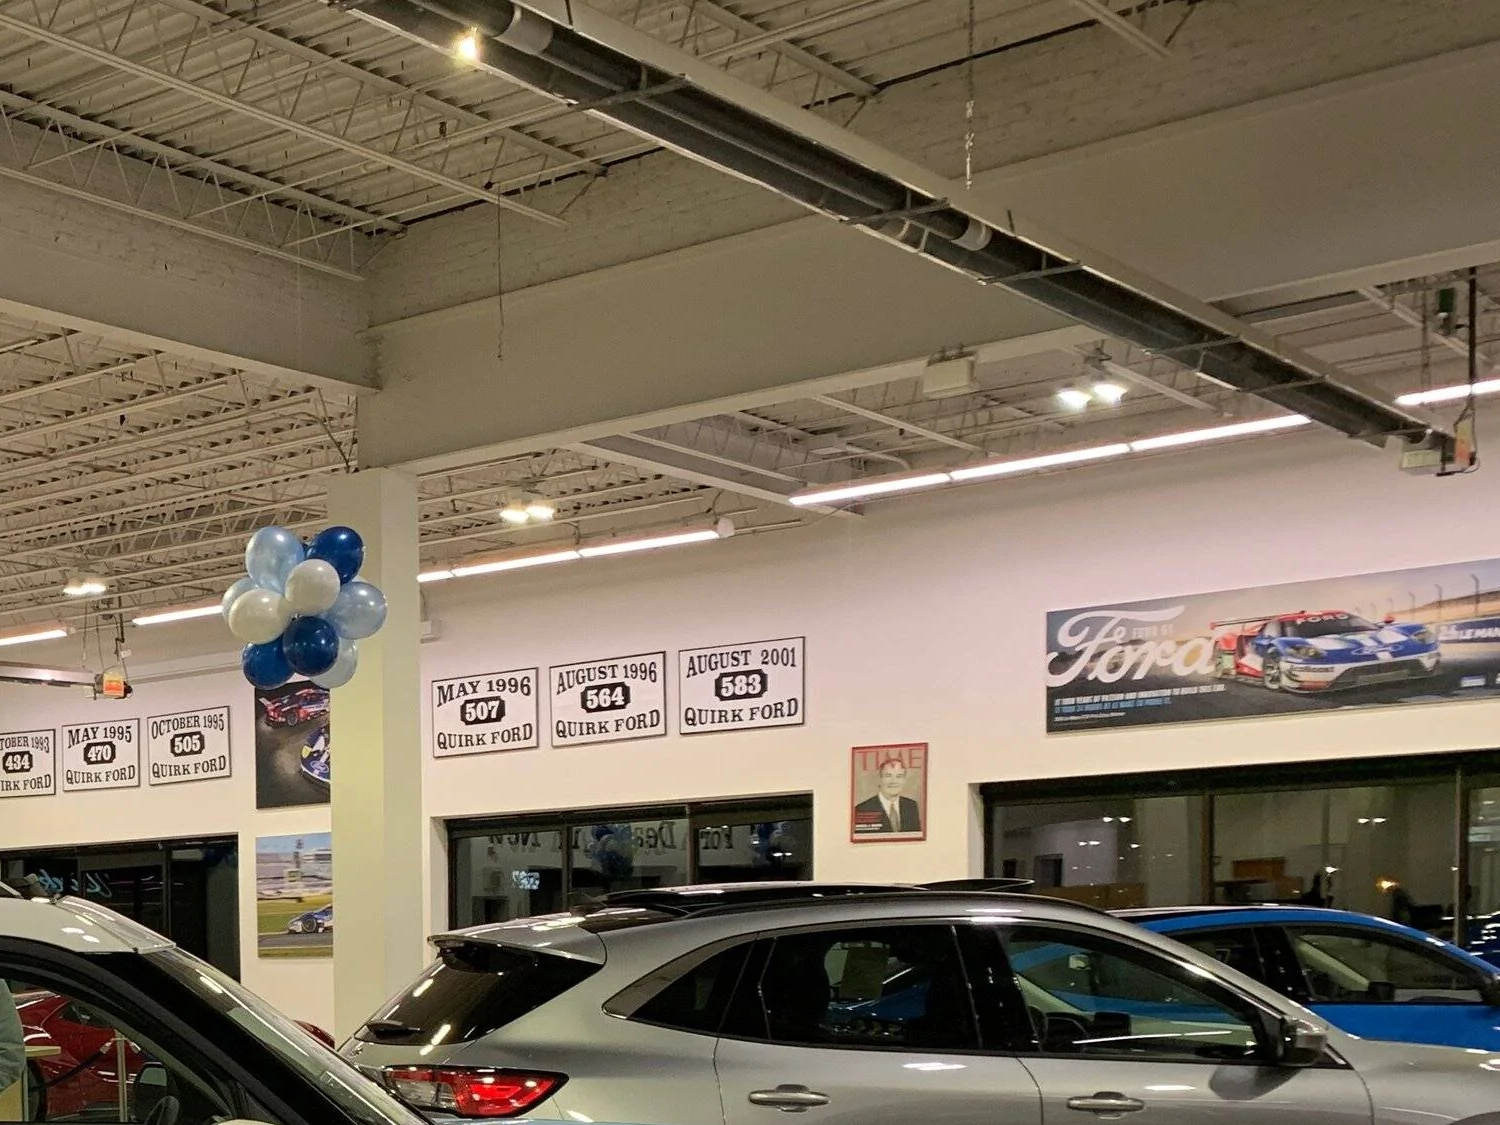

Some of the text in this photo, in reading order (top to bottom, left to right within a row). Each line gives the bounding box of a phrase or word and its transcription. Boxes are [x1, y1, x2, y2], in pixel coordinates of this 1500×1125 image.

[1045, 604, 1216, 688] Ford
[686, 647, 796, 678] AUGUST 2001
[556, 661, 658, 695] AUGUST 1996
[720, 674, 761, 697] 583
[437, 676, 532, 707] MAY 1996
[586, 687, 625, 709] 564
[465, 700, 500, 722] 507
[684, 698, 798, 726] QUIRK FORD
[151, 714, 225, 739] OCTOBER 1995
[556, 709, 660, 738] QUIRK FORD
[31, 736, 50, 754] 1993
[67, 725, 132, 749] MAY 1995
[174, 734, 201, 754] 505
[437, 723, 533, 749] QUIRK FORD
[5, 754, 30, 771] 434
[87, 744, 112, 762] 470
[856, 749, 922, 771] TIME
[66, 764, 136, 784] QUIRK FORD
[152, 755, 226, 778] QUIRK FORD
[23, 774, 51, 789] FORD
